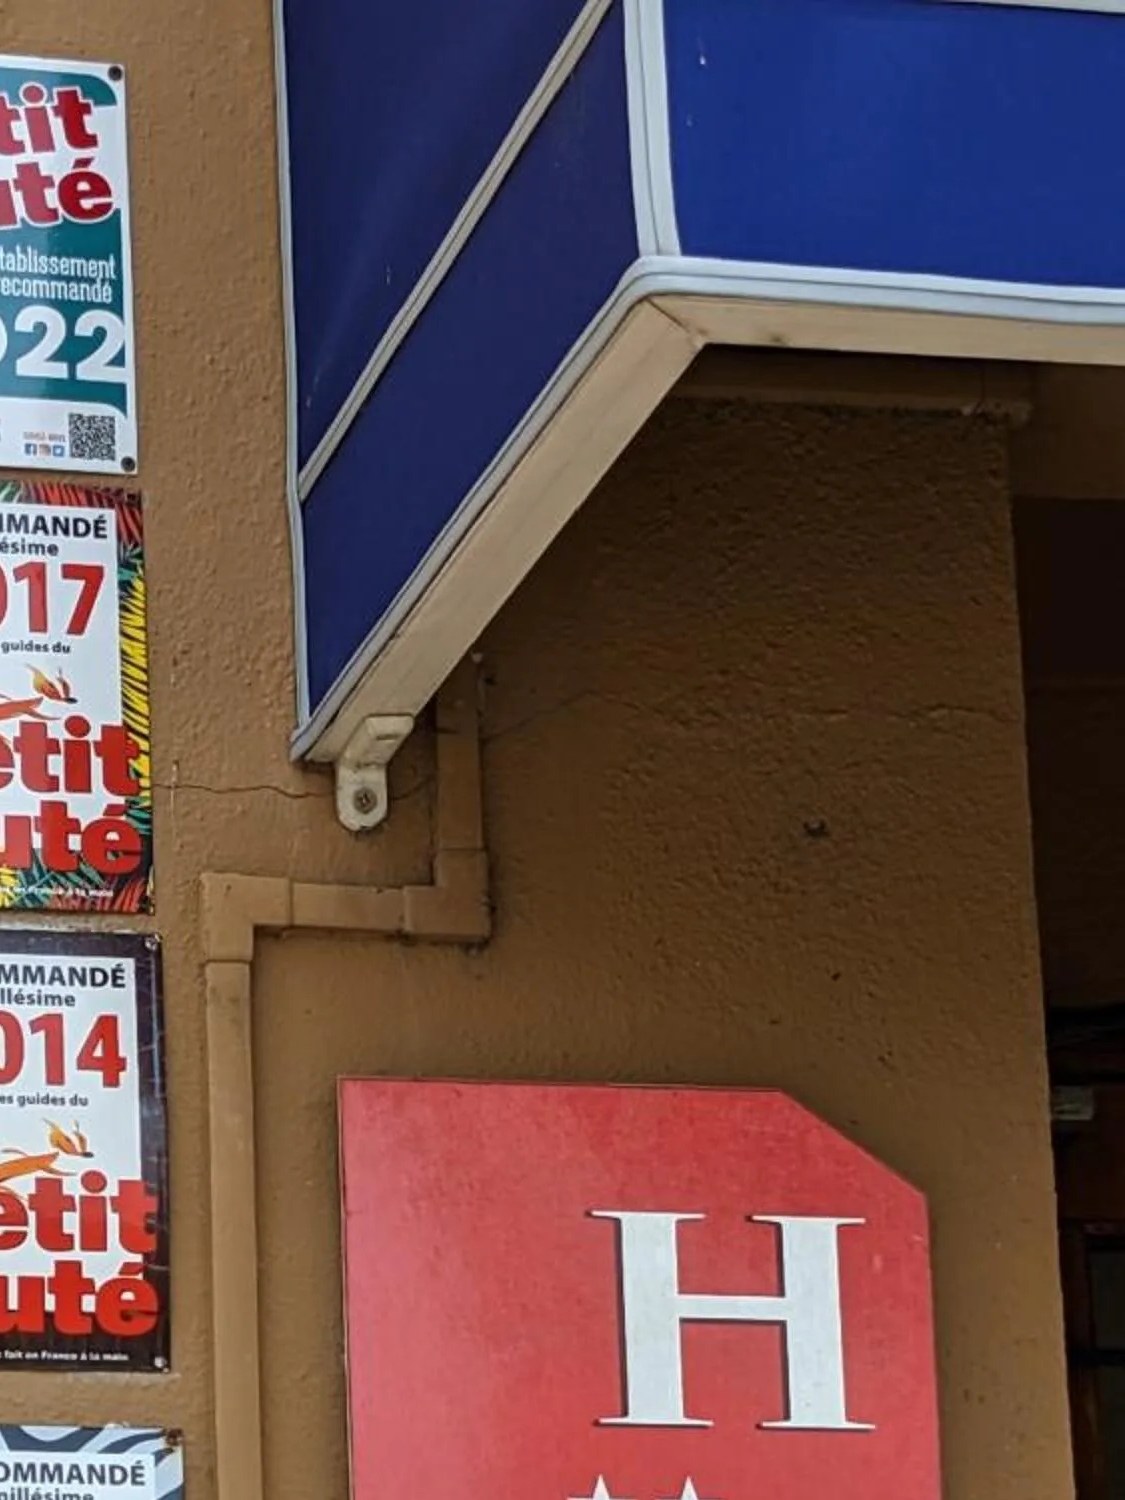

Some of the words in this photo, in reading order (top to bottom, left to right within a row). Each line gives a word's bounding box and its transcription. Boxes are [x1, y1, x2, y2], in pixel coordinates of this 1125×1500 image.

[17, 1092, 66, 1107] guides
[69, 1094, 89, 1106] du
[589, 1210, 877, 1431] H
